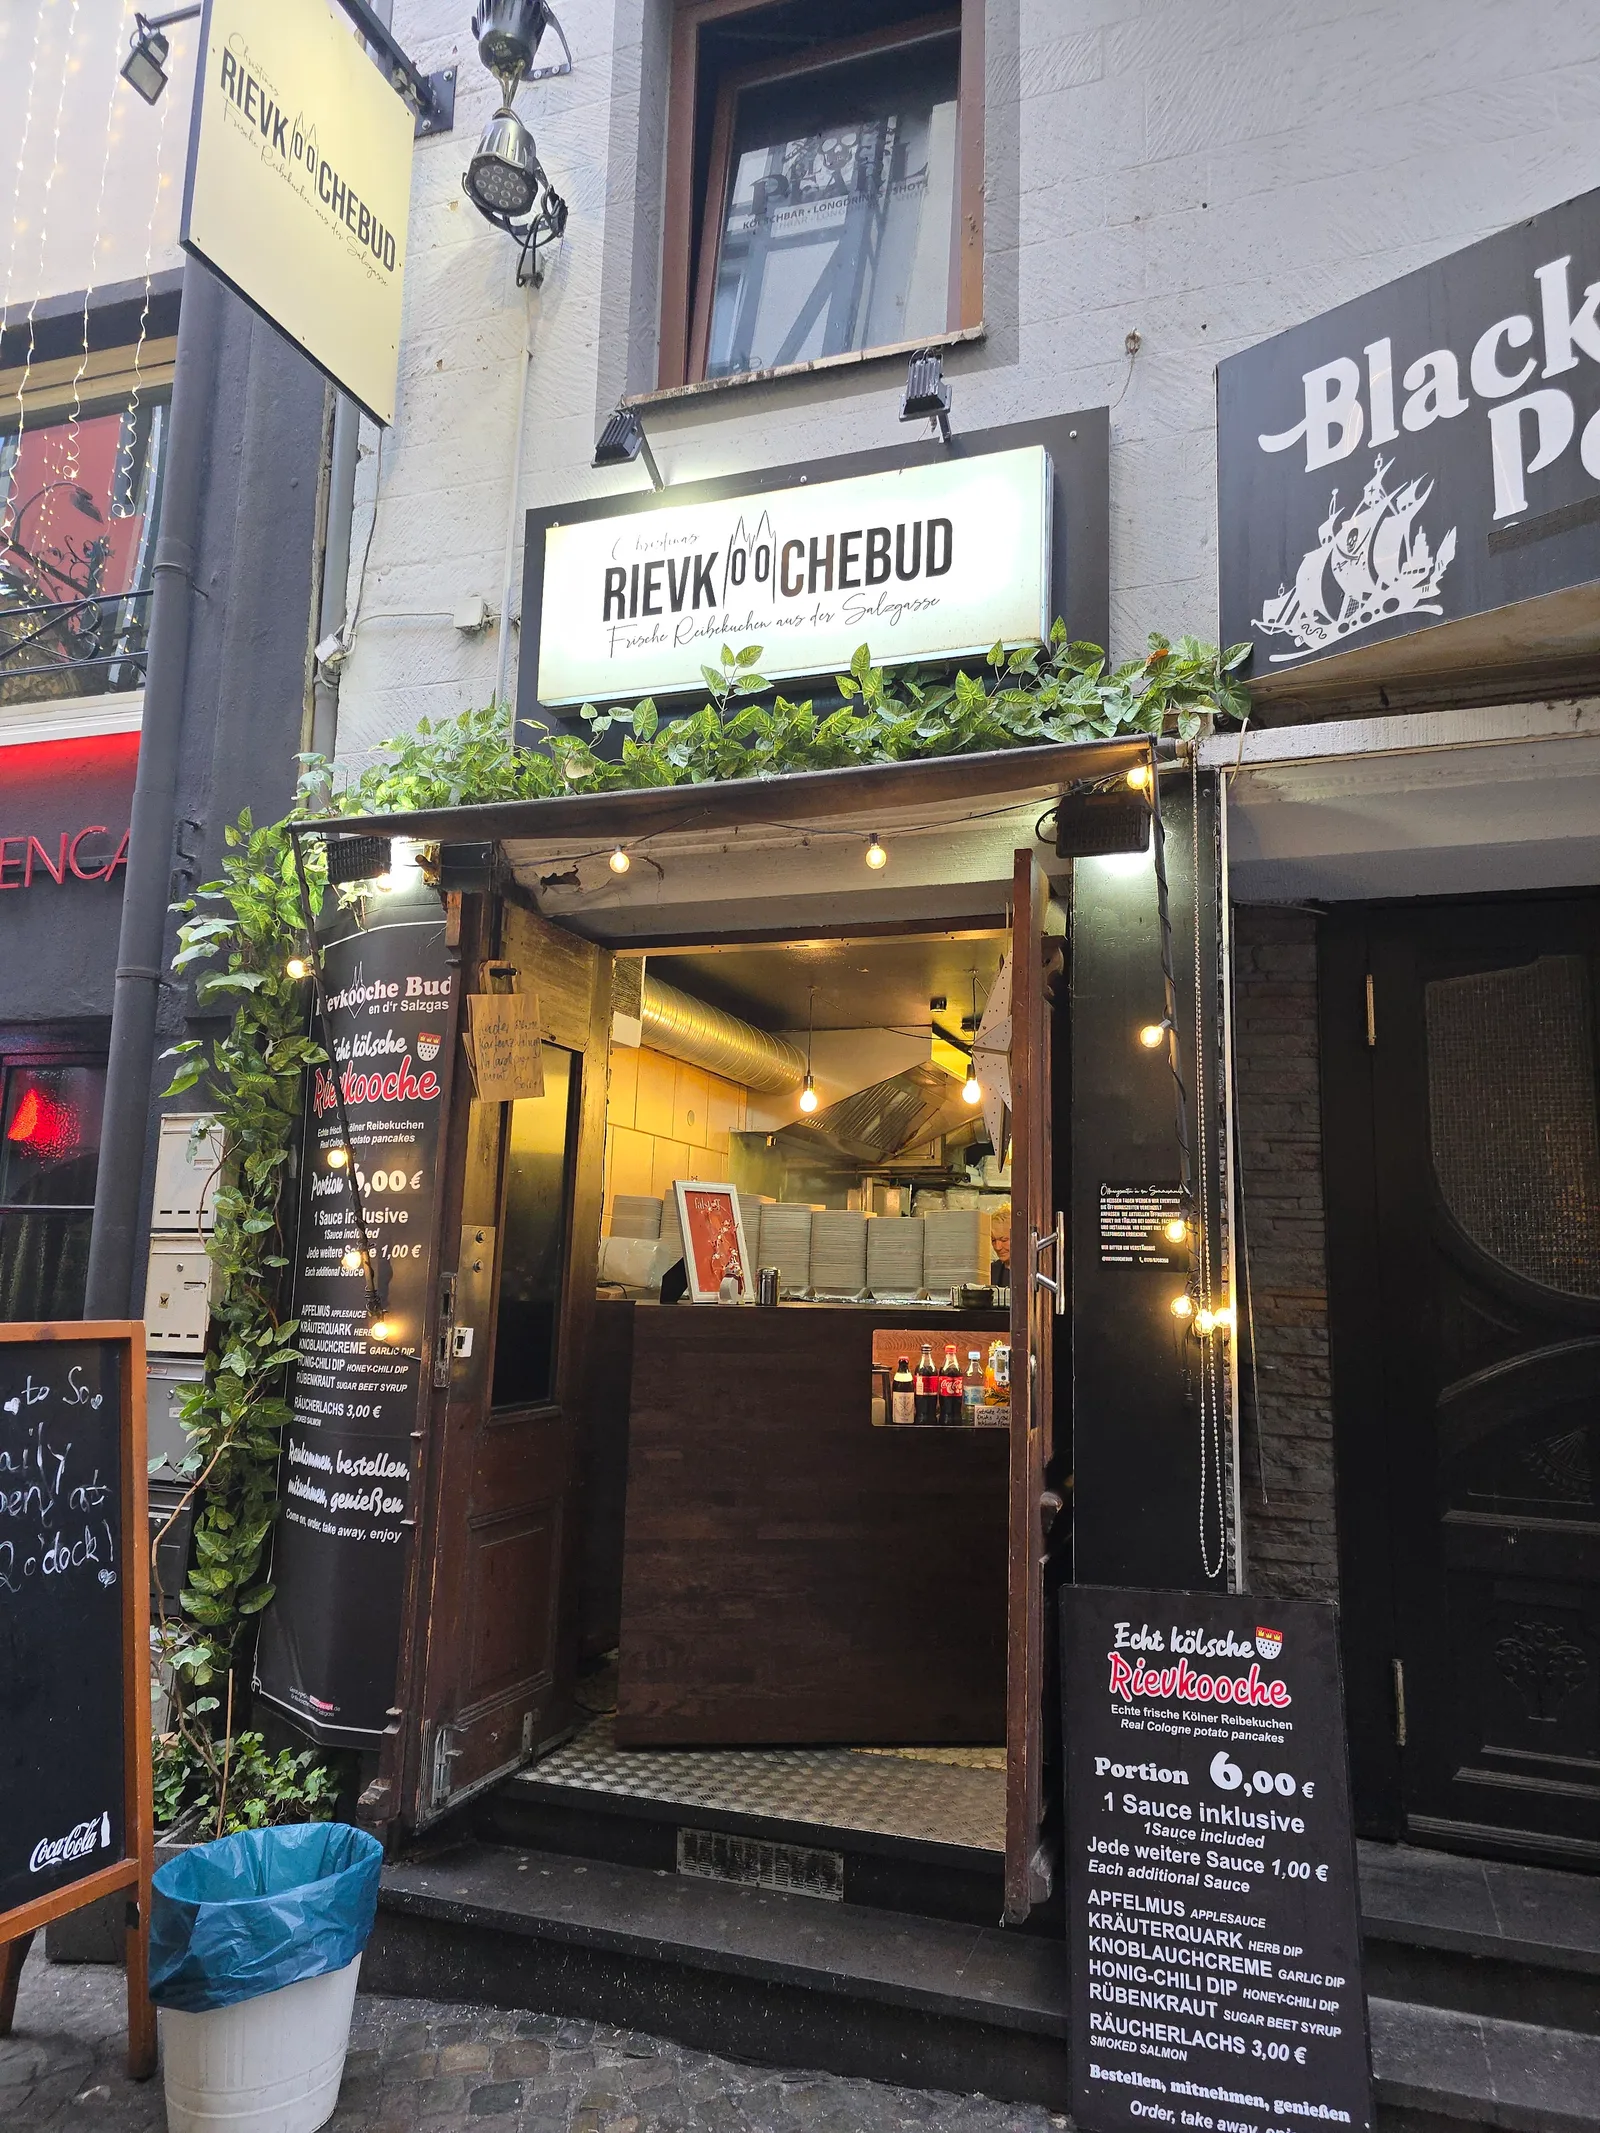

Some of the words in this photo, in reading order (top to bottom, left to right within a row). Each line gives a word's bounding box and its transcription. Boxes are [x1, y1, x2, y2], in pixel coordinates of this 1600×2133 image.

[222, 95, 259, 148] Frische
[607, 623, 668, 658] Frische
[674, 611, 771, 648] Reibekuchen
[776, 615, 806, 629] aus
[810, 602, 834, 627] der
[843, 591, 940, 627] Salzgasse
[405, 976, 451, 997] Bud
[369, 1005, 379, 1014] en
[352, 1029, 407, 1058] kölsche
[366, 1120, 424, 1131] Reibekuchen
[371, 1133, 415, 1146] pancakes
[311, 1172, 344, 1201] Portion
[410, 1170, 423, 1189] €
[314, 1211, 318, 1226] 1
[319, 1210, 342, 1226] Sauce
[307, 1246, 319, 1259] Jede
[320, 1246, 342, 1258] weitere
[381, 1245, 408, 1260] 1,00
[412, 1245, 421, 1258] €
[305, 1266, 315, 1277] Each
[316, 1265, 340, 1277] additional
[340, 1266, 364, 1277] Sauce
[301, 1304, 330, 1317] APFELMUS
[331, 1309, 367, 1318] APPLESAUCE
[300, 1319, 352, 1336] KRÄUTERQUARK
[299, 1338, 367, 1354] KNOBLAUCHCREME
[369, 1346, 399, 1355] GARLIC
[401, 1347, 415, 1355] DIP
[296, 1370, 335, 1389] RÜBENKRAUT
[336, 1380, 356, 1390] SUGAR
[358, 1382, 379, 1391] BEET
[380, 1383, 407, 1392] SYRUP
[333, 1358, 345, 1372] DIP
[347, 1363, 393, 1374] HONEY-CHILI
[394, 1365, 408, 1374] DIP
[21, 1375, 50, 1405] to
[294, 1394, 344, 1417] RÄUCHERLACHS
[346, 1404, 370, 1419] 3,00
[373, 1405, 382, 1418] €
[289, 1438, 333, 1475] Rankommen,
[336, 1449, 410, 1481] bestellen,
[288, 1475, 327, 1508] mitnehmen,
[330, 1487, 403, 1517] genießen
[286, 1508, 299, 1522] Come
[307, 1515, 321, 1532] order,
[322, 1521, 336, 1535] take
[337, 1526, 366, 1540] away,
[370, 1528, 402, 1543] enjoy
[1114, 1622, 1165, 1651] Echt
[1170, 1626, 1256, 1659] kölsche
[1108, 1651, 1292, 1708] Rievkooche
[1111, 1704, 1141, 1716] Echte
[1143, 1707, 1180, 1721] frische
[1182, 1711, 1218, 1724] Kölner
[1221, 1714, 1293, 1731] Reibekuchen
[1121, 1719, 1144, 1730] Real
[1147, 1721, 1191, 1735] Cologne
[1193, 1727, 1229, 1738] potato
[1231, 1730, 1285, 1743] pancakes
[1094, 1757, 1189, 1785] Portion
[1210, 1751, 1296, 1797] 6,00
[1302, 1782, 1315, 1798] €
[1104, 1792, 1114, 1812] 1
[1122, 1793, 1192, 1820] Sauce
[1200, 1802, 1305, 1833] inklusive
[1200, 1828, 1265, 1849] included
[1087, 1836, 1130, 1856] Jede
[1134, 1845, 1201, 1865] weitere
[1206, 1850, 1265, 1874] Sauce
[1271, 1859, 1311, 1879] 1,00
[1315, 1864, 1329, 1882] €
[1088, 1859, 1123, 1876] Each
[1127, 1866, 1200, 1886] additional
[1203, 1874, 1250, 1892] Sauce
[1087, 1889, 1185, 1917] APFELMUS
[1190, 1909, 1266, 1928] APPLESAUCE
[1088, 1911, 1244, 1950] KRÄUTERQUARK
[1249, 1940, 1280, 1954] HERB
[1283, 1945, 1303, 1957] DIP
[1089, 1935, 1273, 1978] KNOBLAUCHCREME
[1278, 1969, 1322, 1985] GARLIC
[1325, 1975, 1345, 1988] DIP
[1089, 1958, 1201, 1991] HONIG-CHILI
[1207, 1976, 1238, 1996] DIP
[1243, 1988, 1316, 2009] HONEY-CHILI
[1319, 2000, 1340, 2012] DIP
[1089, 1981, 1218, 2018] RÜBENKRAUT
[1223, 2010, 1264, 2026] SUGAR
[1267, 2016, 1299, 2031] BEET
[1301, 2021, 1342, 2037] SYRUP
[1090, 2012, 1246, 2054] RÄUCHERLACHS
[1251, 2040, 1290, 2061] 3,00
[1294, 2046, 1307, 2064] €
[1090, 2035, 1137, 2052] SMOKED
[1139, 2043, 1188, 2061] SALMON
[1089, 2063, 1167, 2093] Bestellen,
[1170, 2080, 1270, 2111] mitnehmen,
[1274, 2099, 1350, 2123] genießen
[1130, 2101, 1176, 2124] Order,
[1180, 2110, 1213, 2129] take
